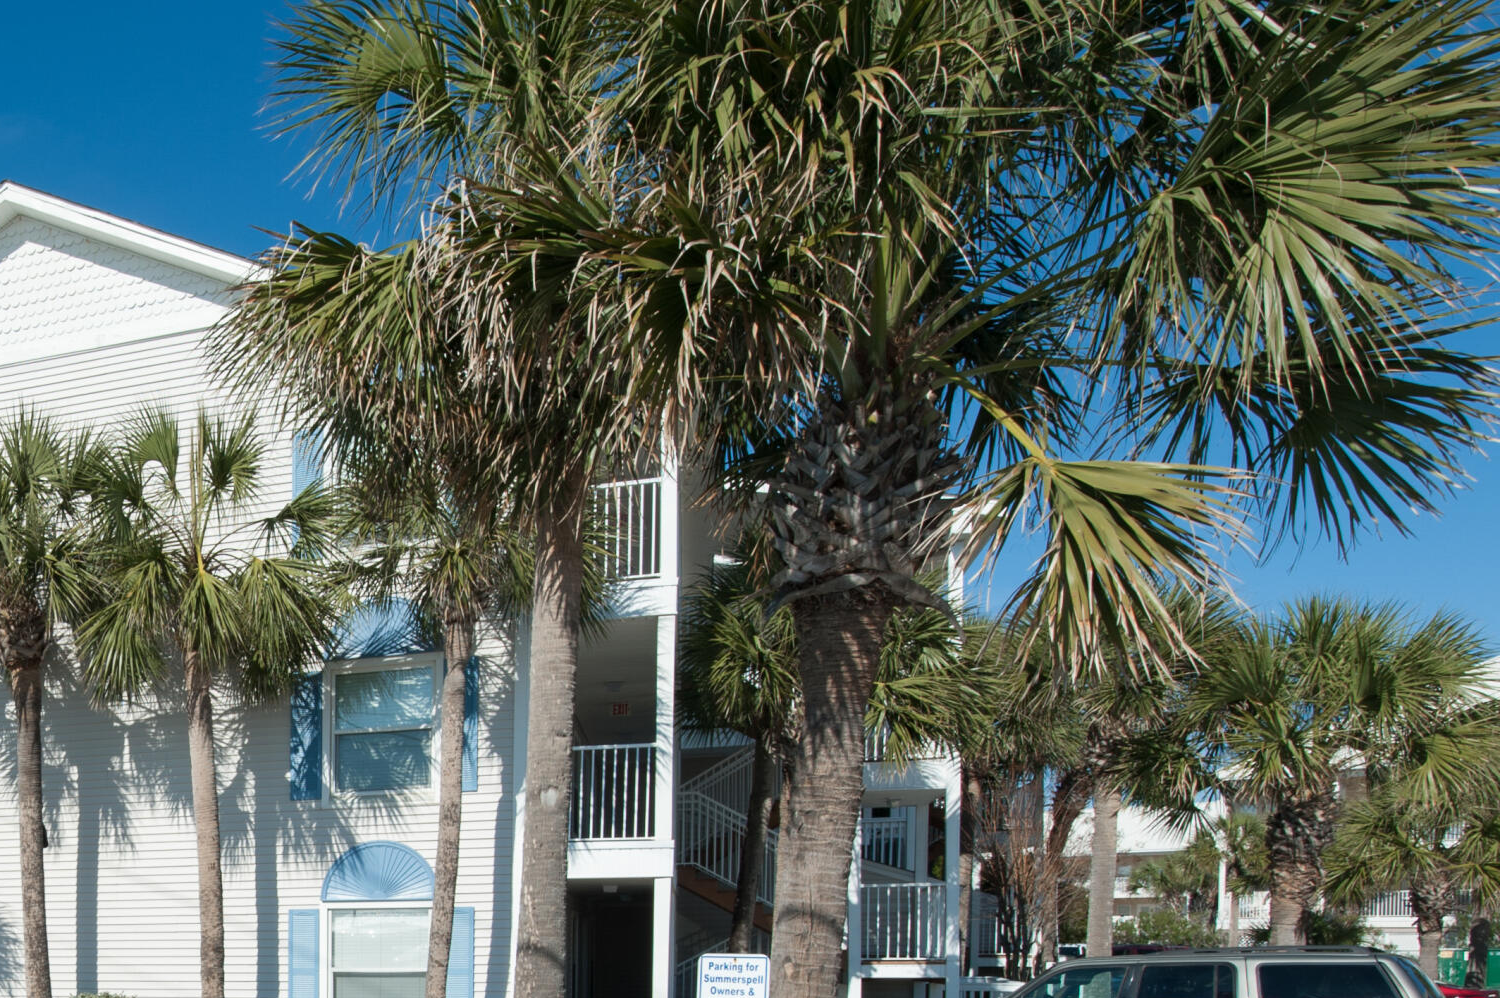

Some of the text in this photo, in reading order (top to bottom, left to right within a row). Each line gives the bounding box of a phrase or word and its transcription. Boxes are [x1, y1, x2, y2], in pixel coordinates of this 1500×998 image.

[708, 961, 759, 973] Parking for
[704, 974, 764, 985] Summerspell
[710, 986, 755, 996] Owners &
